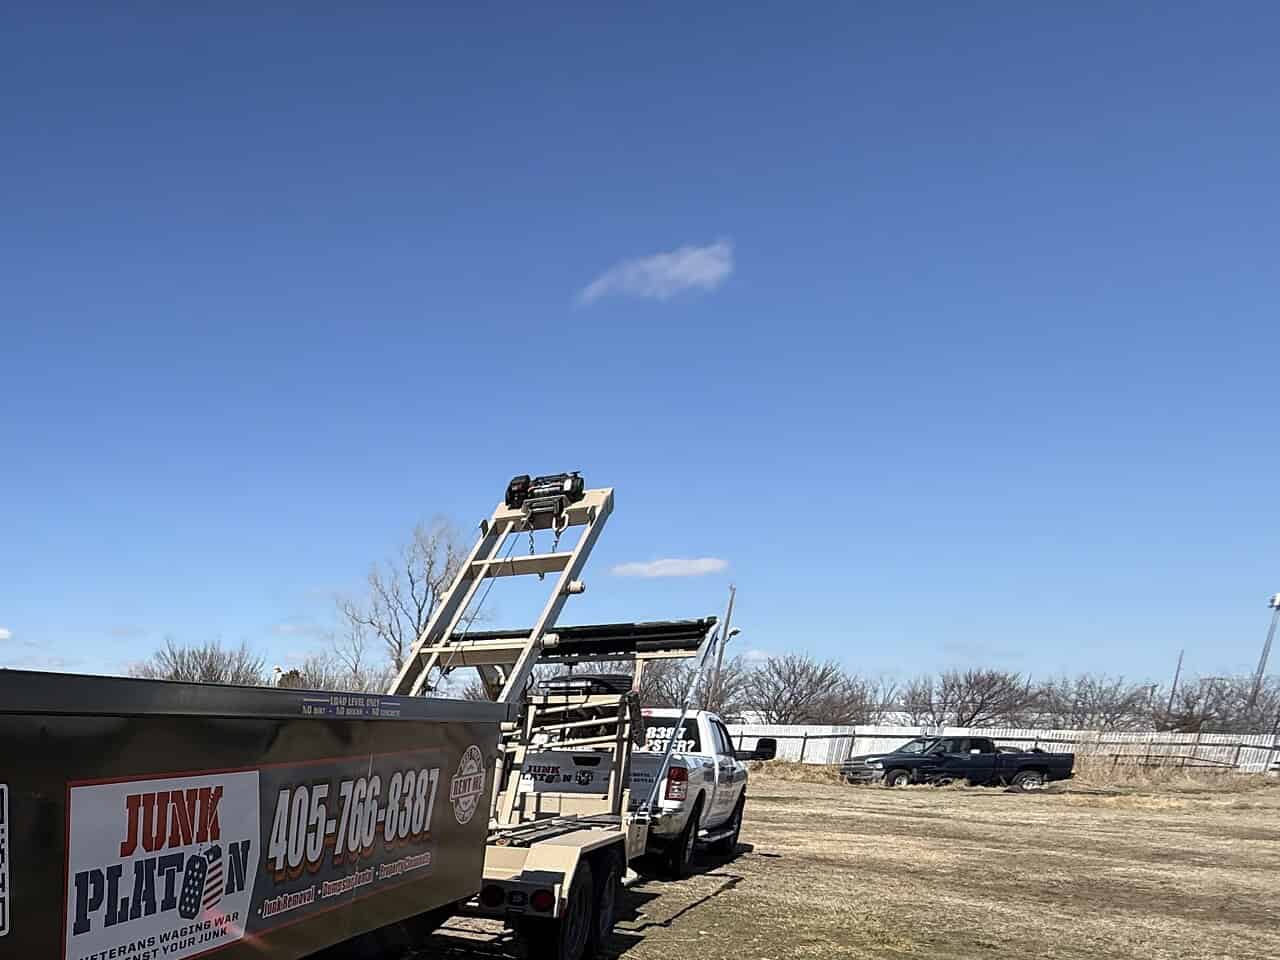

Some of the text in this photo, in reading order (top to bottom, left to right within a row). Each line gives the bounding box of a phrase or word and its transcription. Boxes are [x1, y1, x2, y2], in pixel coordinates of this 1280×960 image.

[120, 785, 224, 858] JUNK
[268, 768, 440, 874] 405-766-8387
[159, 919, 212, 943] WAGING
[212, 912, 239, 928] WAR
[161, 936, 196, 956] YOUR
[198, 926, 228, 945] JUNK
